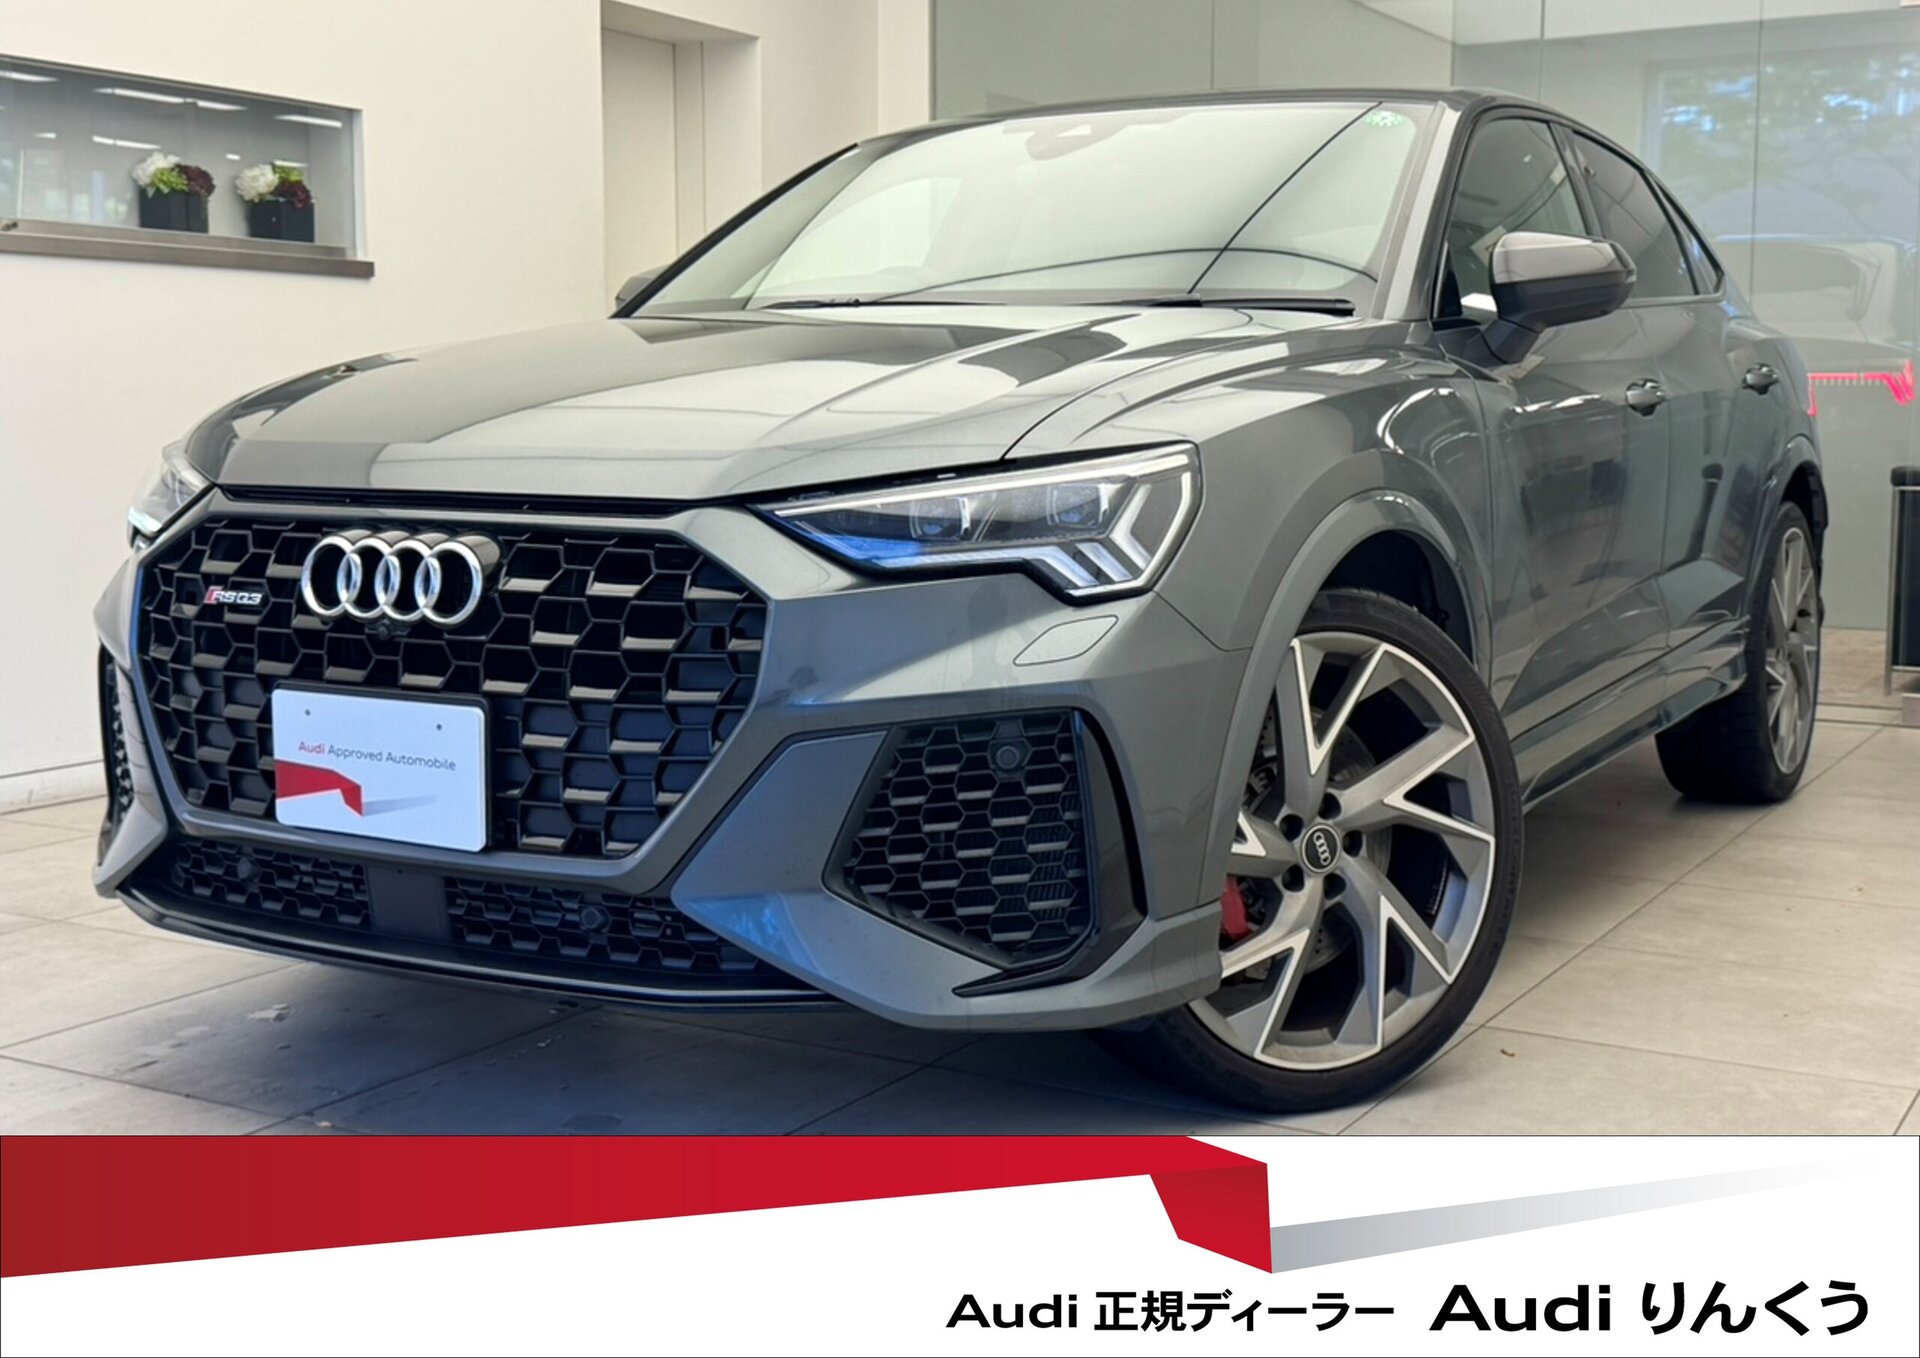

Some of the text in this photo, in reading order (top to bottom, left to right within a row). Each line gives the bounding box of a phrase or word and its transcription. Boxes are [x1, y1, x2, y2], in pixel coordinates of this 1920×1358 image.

[298, 741, 456, 771] Audi Approved Automobile
